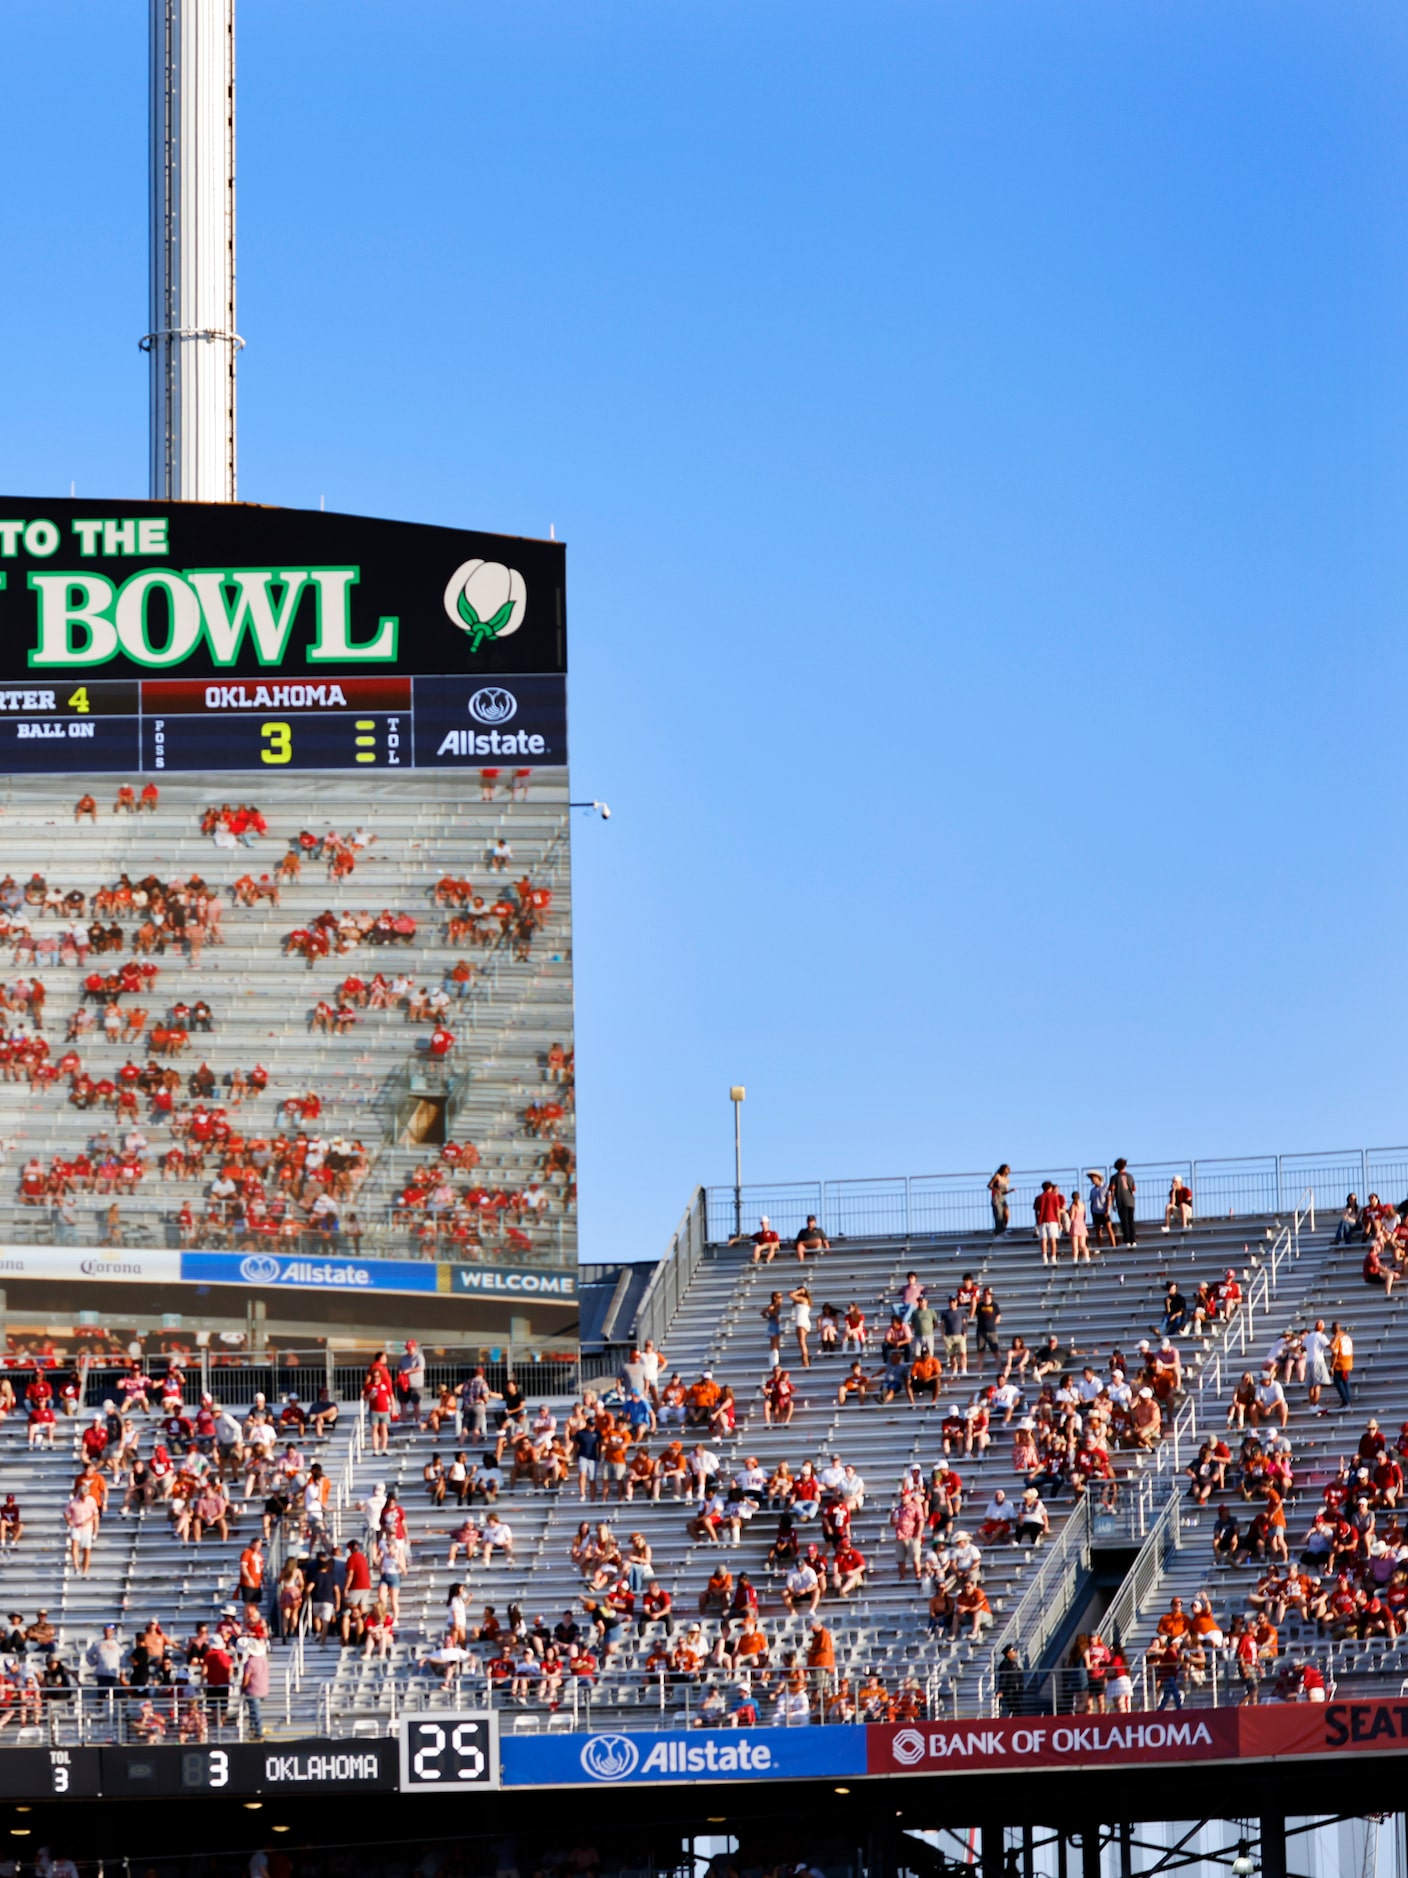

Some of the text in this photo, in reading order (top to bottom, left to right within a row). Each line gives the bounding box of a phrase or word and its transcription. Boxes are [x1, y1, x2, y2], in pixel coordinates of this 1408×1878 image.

[72, 517, 169, 556] THE
[27, 565, 399, 668] BOWL
[68, 687, 90, 713] 4
[205, 685, 347, 709] OKLAHOMA
[17, 722, 95, 738] BALL ON
[260, 721, 292, 764] 3
[437, 729, 545, 756] Allstate
[80, 1258, 142, 1276] Corona
[280, 1263, 370, 1285] Allstate
[461, 1271, 574, 1293] WELCOME
[414, 1723, 484, 1780] 25
[929, 1722, 1213, 1757] BANK OF OKLAHOMA
[50, 1750, 71, 1765] TOL
[208, 1750, 229, 1788] 3
[265, 1753, 378, 1782] OKLAHOMA
[641, 1739, 772, 1773] Allstate
[54, 1767, 69, 1792] 3
